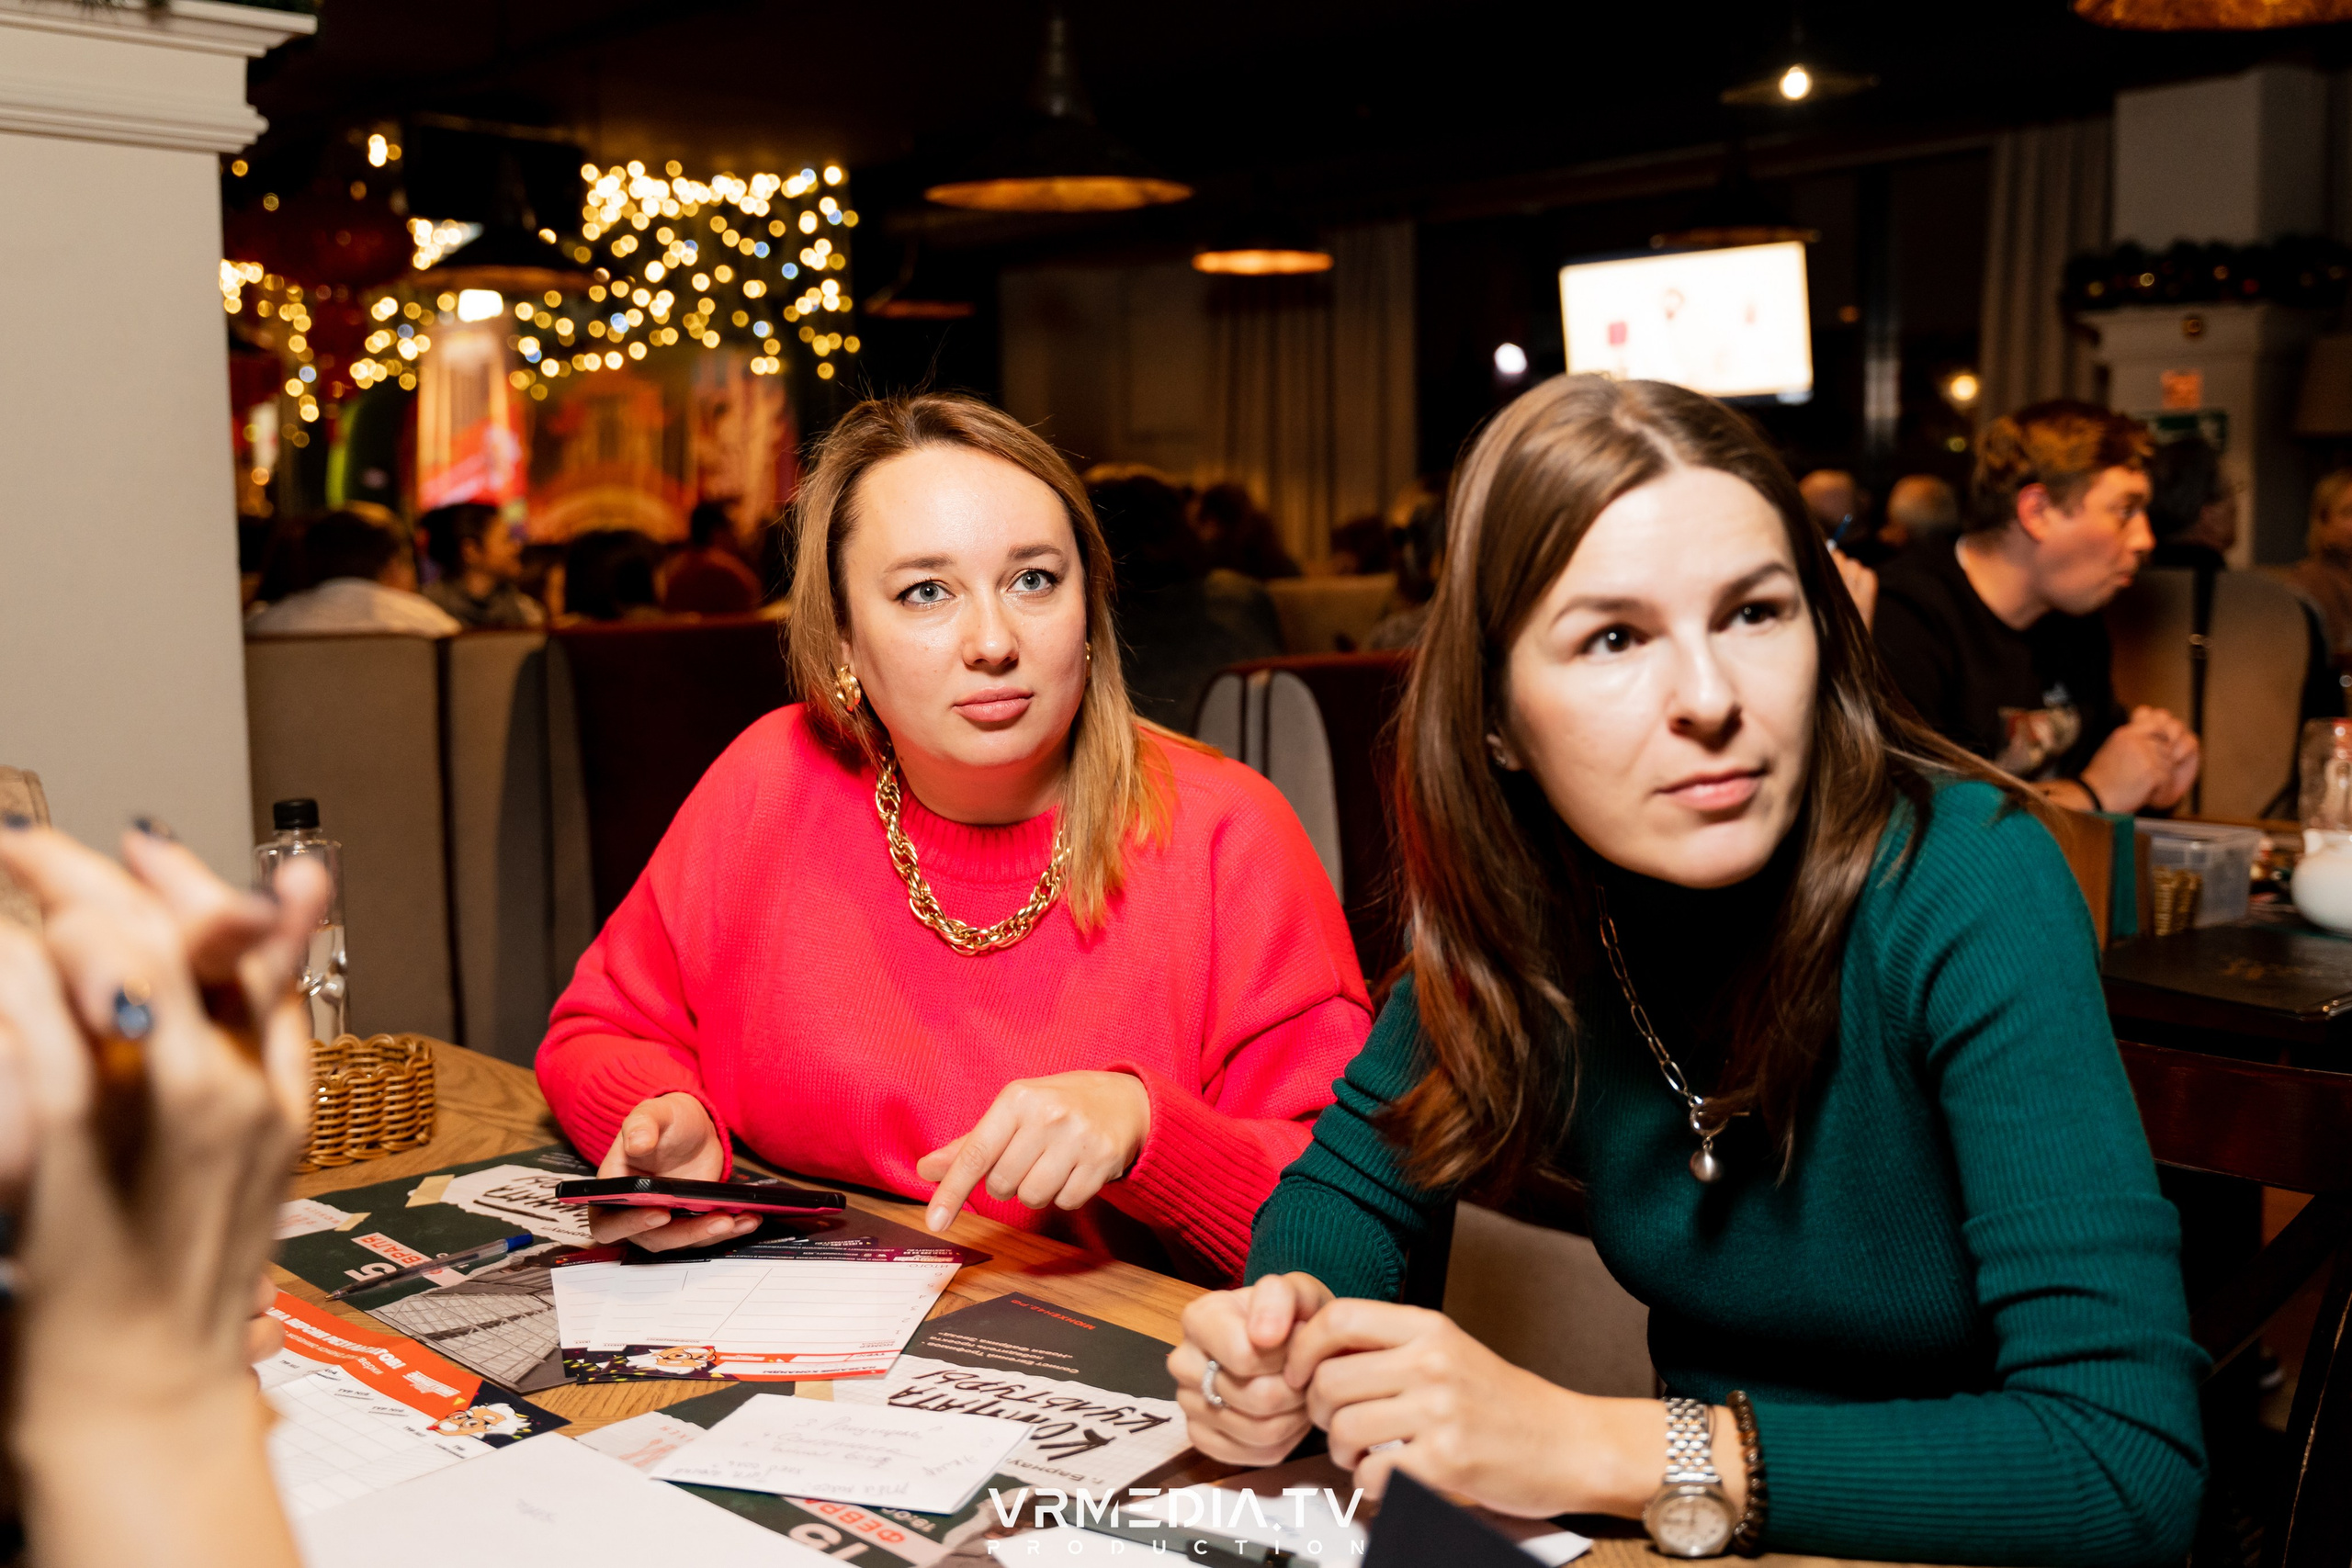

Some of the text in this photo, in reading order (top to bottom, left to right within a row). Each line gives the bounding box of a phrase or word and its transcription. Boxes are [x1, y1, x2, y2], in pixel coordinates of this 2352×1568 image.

[1011, 1299, 1096, 1330] МЮНХЕН42.РФ
[927, 1342, 985, 1357] Трофимов
[929, 1336, 1045, 1359] победитель проекта
[978, 1338, 1030, 1352] Фабрика
[356, 1357, 384, 1375] верки
[986, 1353, 1035, 1366] Евгений
[1035, 1361, 1080, 1374] Солист
[911, 1370, 1172, 1433] КУЛЬТУРЫ
[660, 1426, 695, 1443] ХЕН
